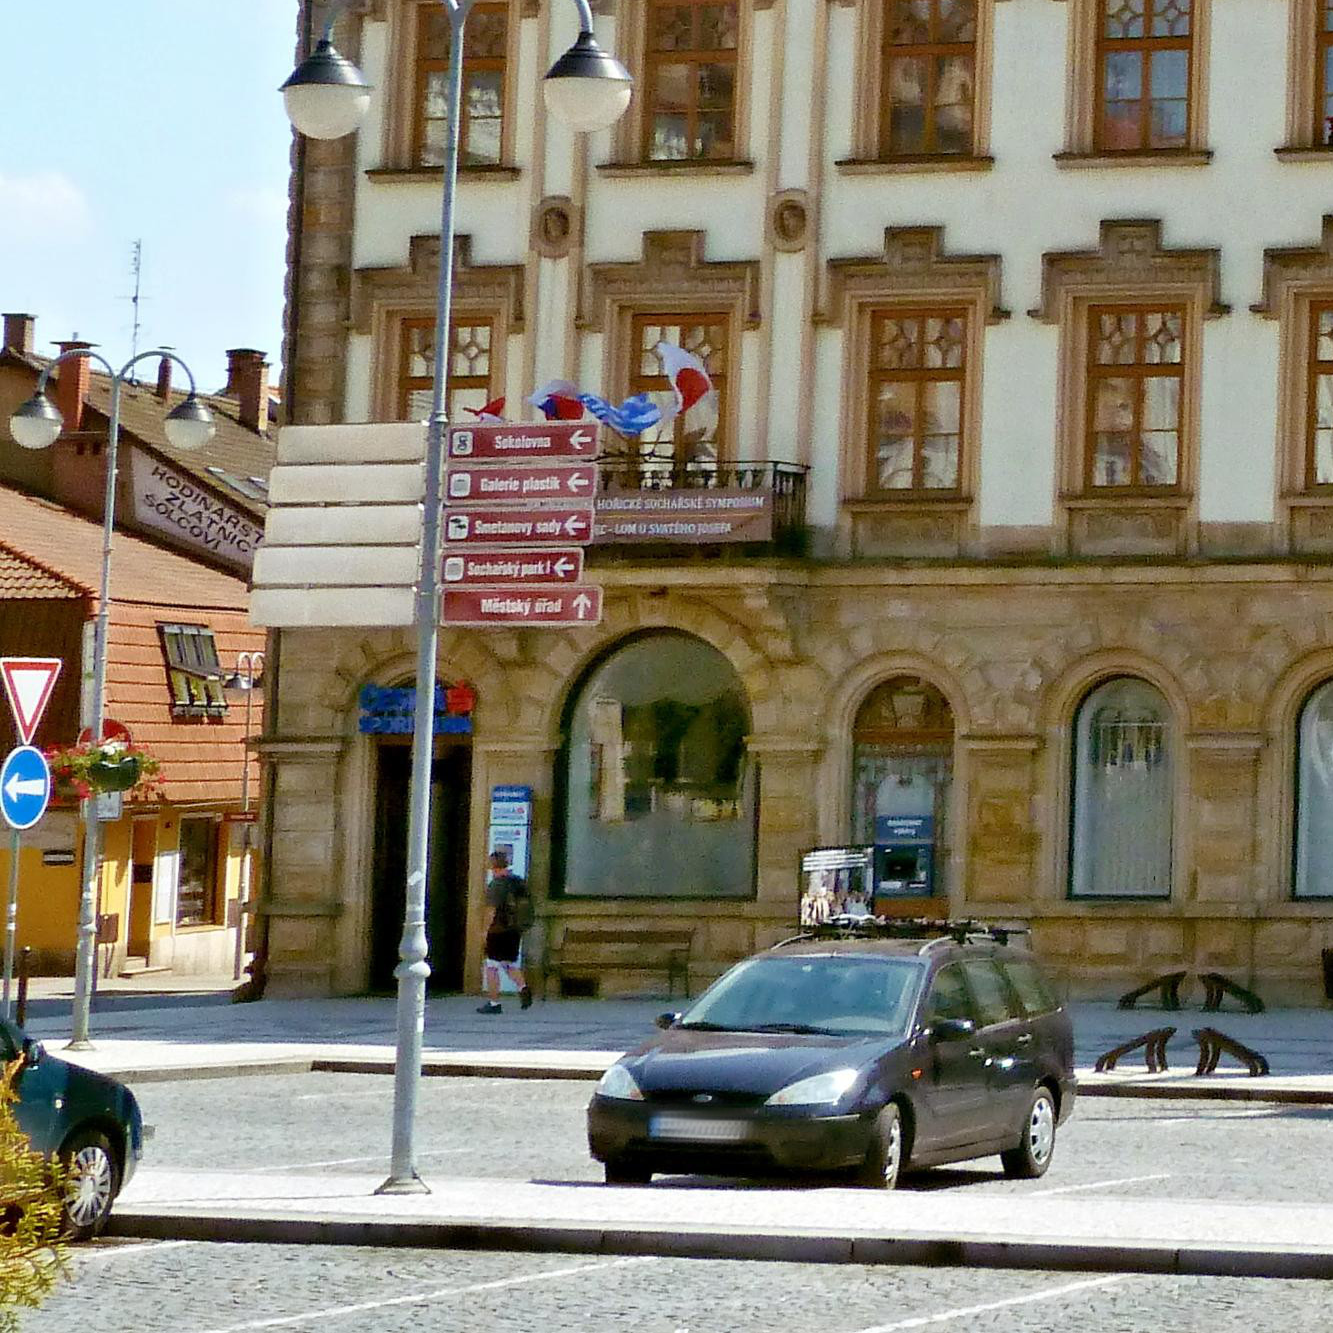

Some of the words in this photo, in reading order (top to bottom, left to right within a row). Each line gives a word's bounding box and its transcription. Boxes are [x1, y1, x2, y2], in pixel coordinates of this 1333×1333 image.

[494, 435, 552, 449] Sokolovna
[480, 477, 519, 492] Galerie
[523, 476, 560, 493] plastik
[475, 520, 533, 535] Smetanovy
[536, 519, 562, 535] sady
[521, 560, 544, 577] park
[481, 597, 531, 616] Městský
